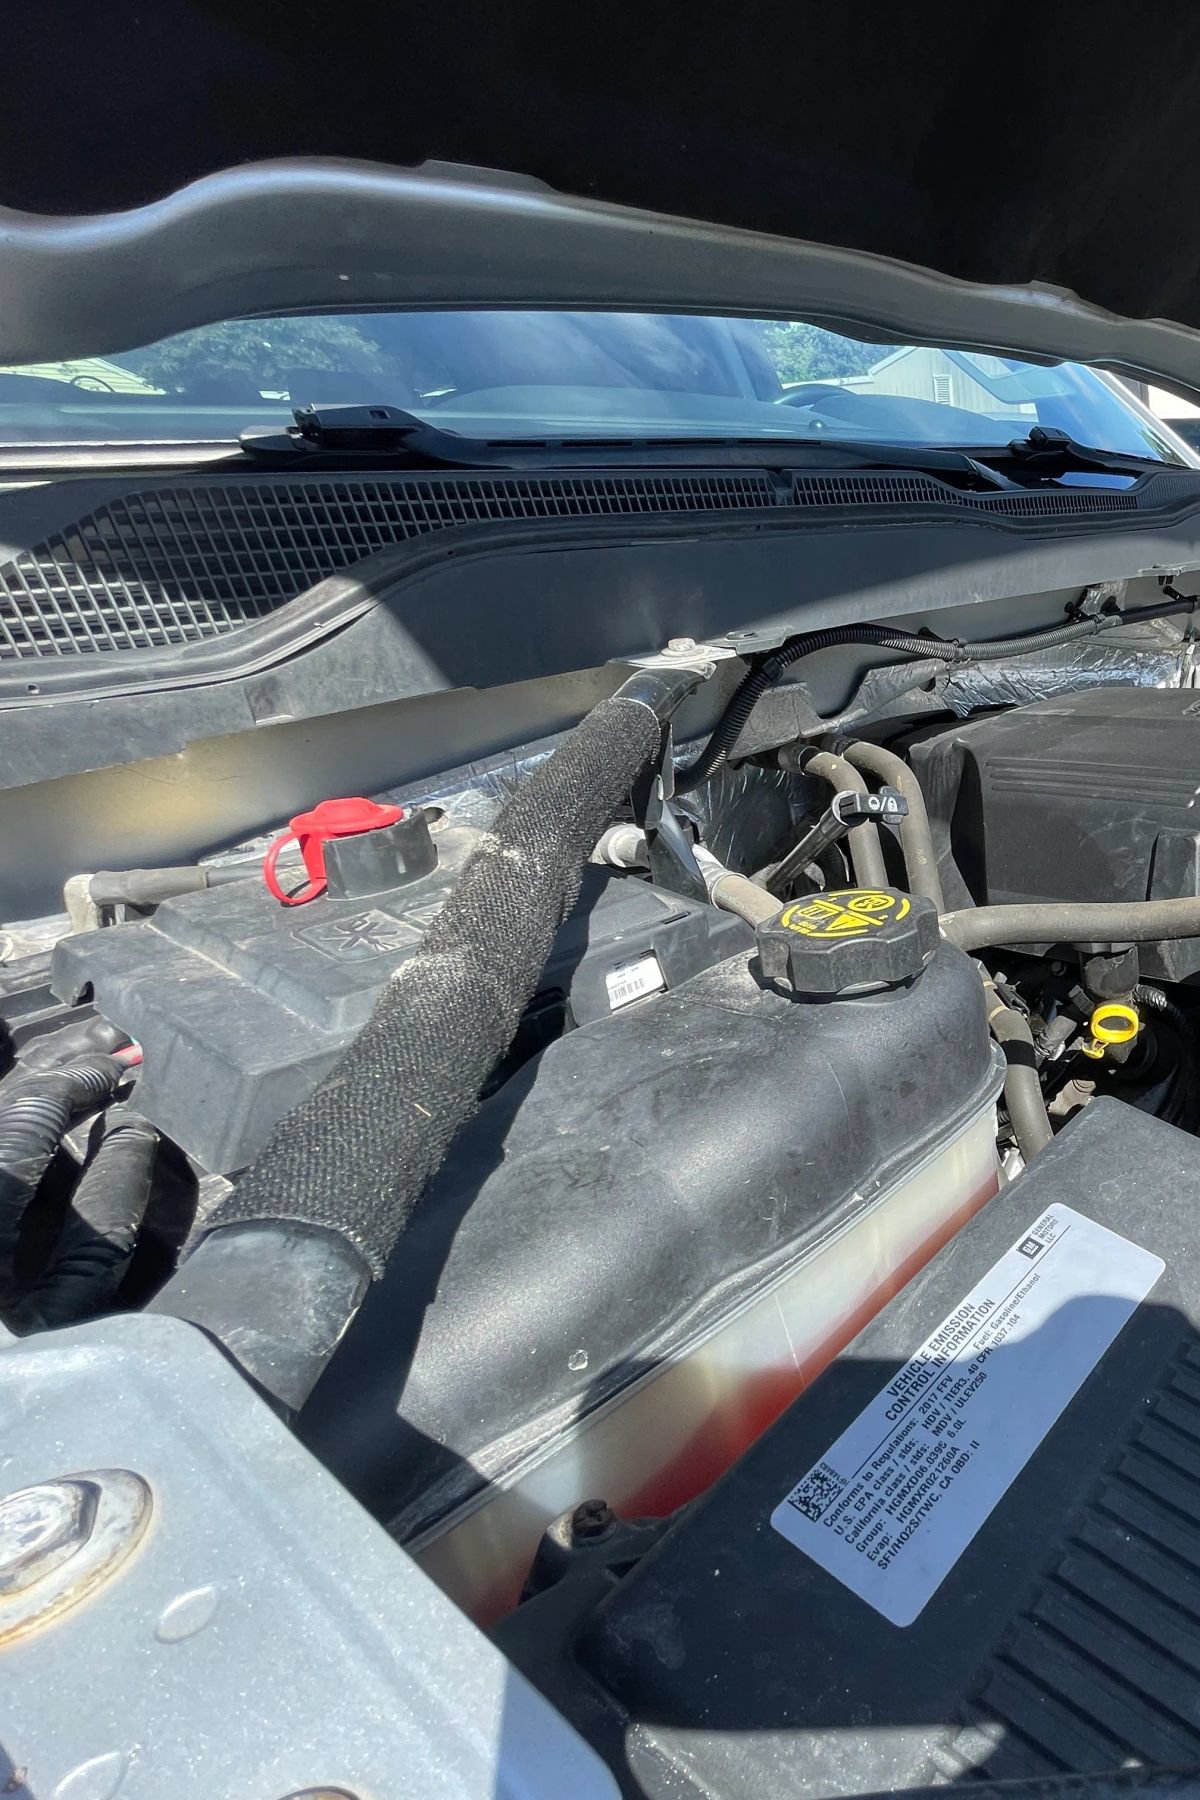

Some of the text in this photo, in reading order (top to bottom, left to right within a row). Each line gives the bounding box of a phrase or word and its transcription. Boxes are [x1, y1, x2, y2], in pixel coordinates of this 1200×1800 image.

[1032, 1215, 1054, 1235] GENERAL
[1039, 1219, 1058, 1239] MOTORS
[823, 1483, 864, 1527] Conforms
[861, 1471, 875, 1483] to
[871, 1418, 919, 1470] Regulations:
[919, 1393, 938, 1414] 2017
[936, 1374, 954, 1394] FFV
[973, 1330, 993, 1349] Fuel:
[991, 1274, 1040, 1330] Gasoline/Ethanol
[885, 1299, 995, 1421] CONTROL INFORMATION
[887, 1303, 975, 1397] VEHICLE EMISSION
[834, 1515, 855, 1535] U.S.
[854, 1492, 874, 1512] EPA
[873, 1467, 894, 1490] class
[898, 1438, 918, 1460] stds:
[922, 1409, 941, 1429] HDV
[943, 1377, 970, 1402] TIER3,
[967, 1363, 980, 1376] 40
[975, 1346, 994, 1364] CFR
[845, 1498, 886, 1544] California
[885, 1473, 906, 1497] class
[910, 1444, 929, 1466] stds:
[932, 1414, 952, 1436] MDV
[955, 1372, 987, 1408] ULEV250
[856, 1519, 886, 1553] Group:
[947, 1419, 966, 1438] 6.0L
[938, 1475, 955, 1490] CA
[951, 1450, 973, 1474] OBD:
[867, 1532, 893, 1561] Evap:
